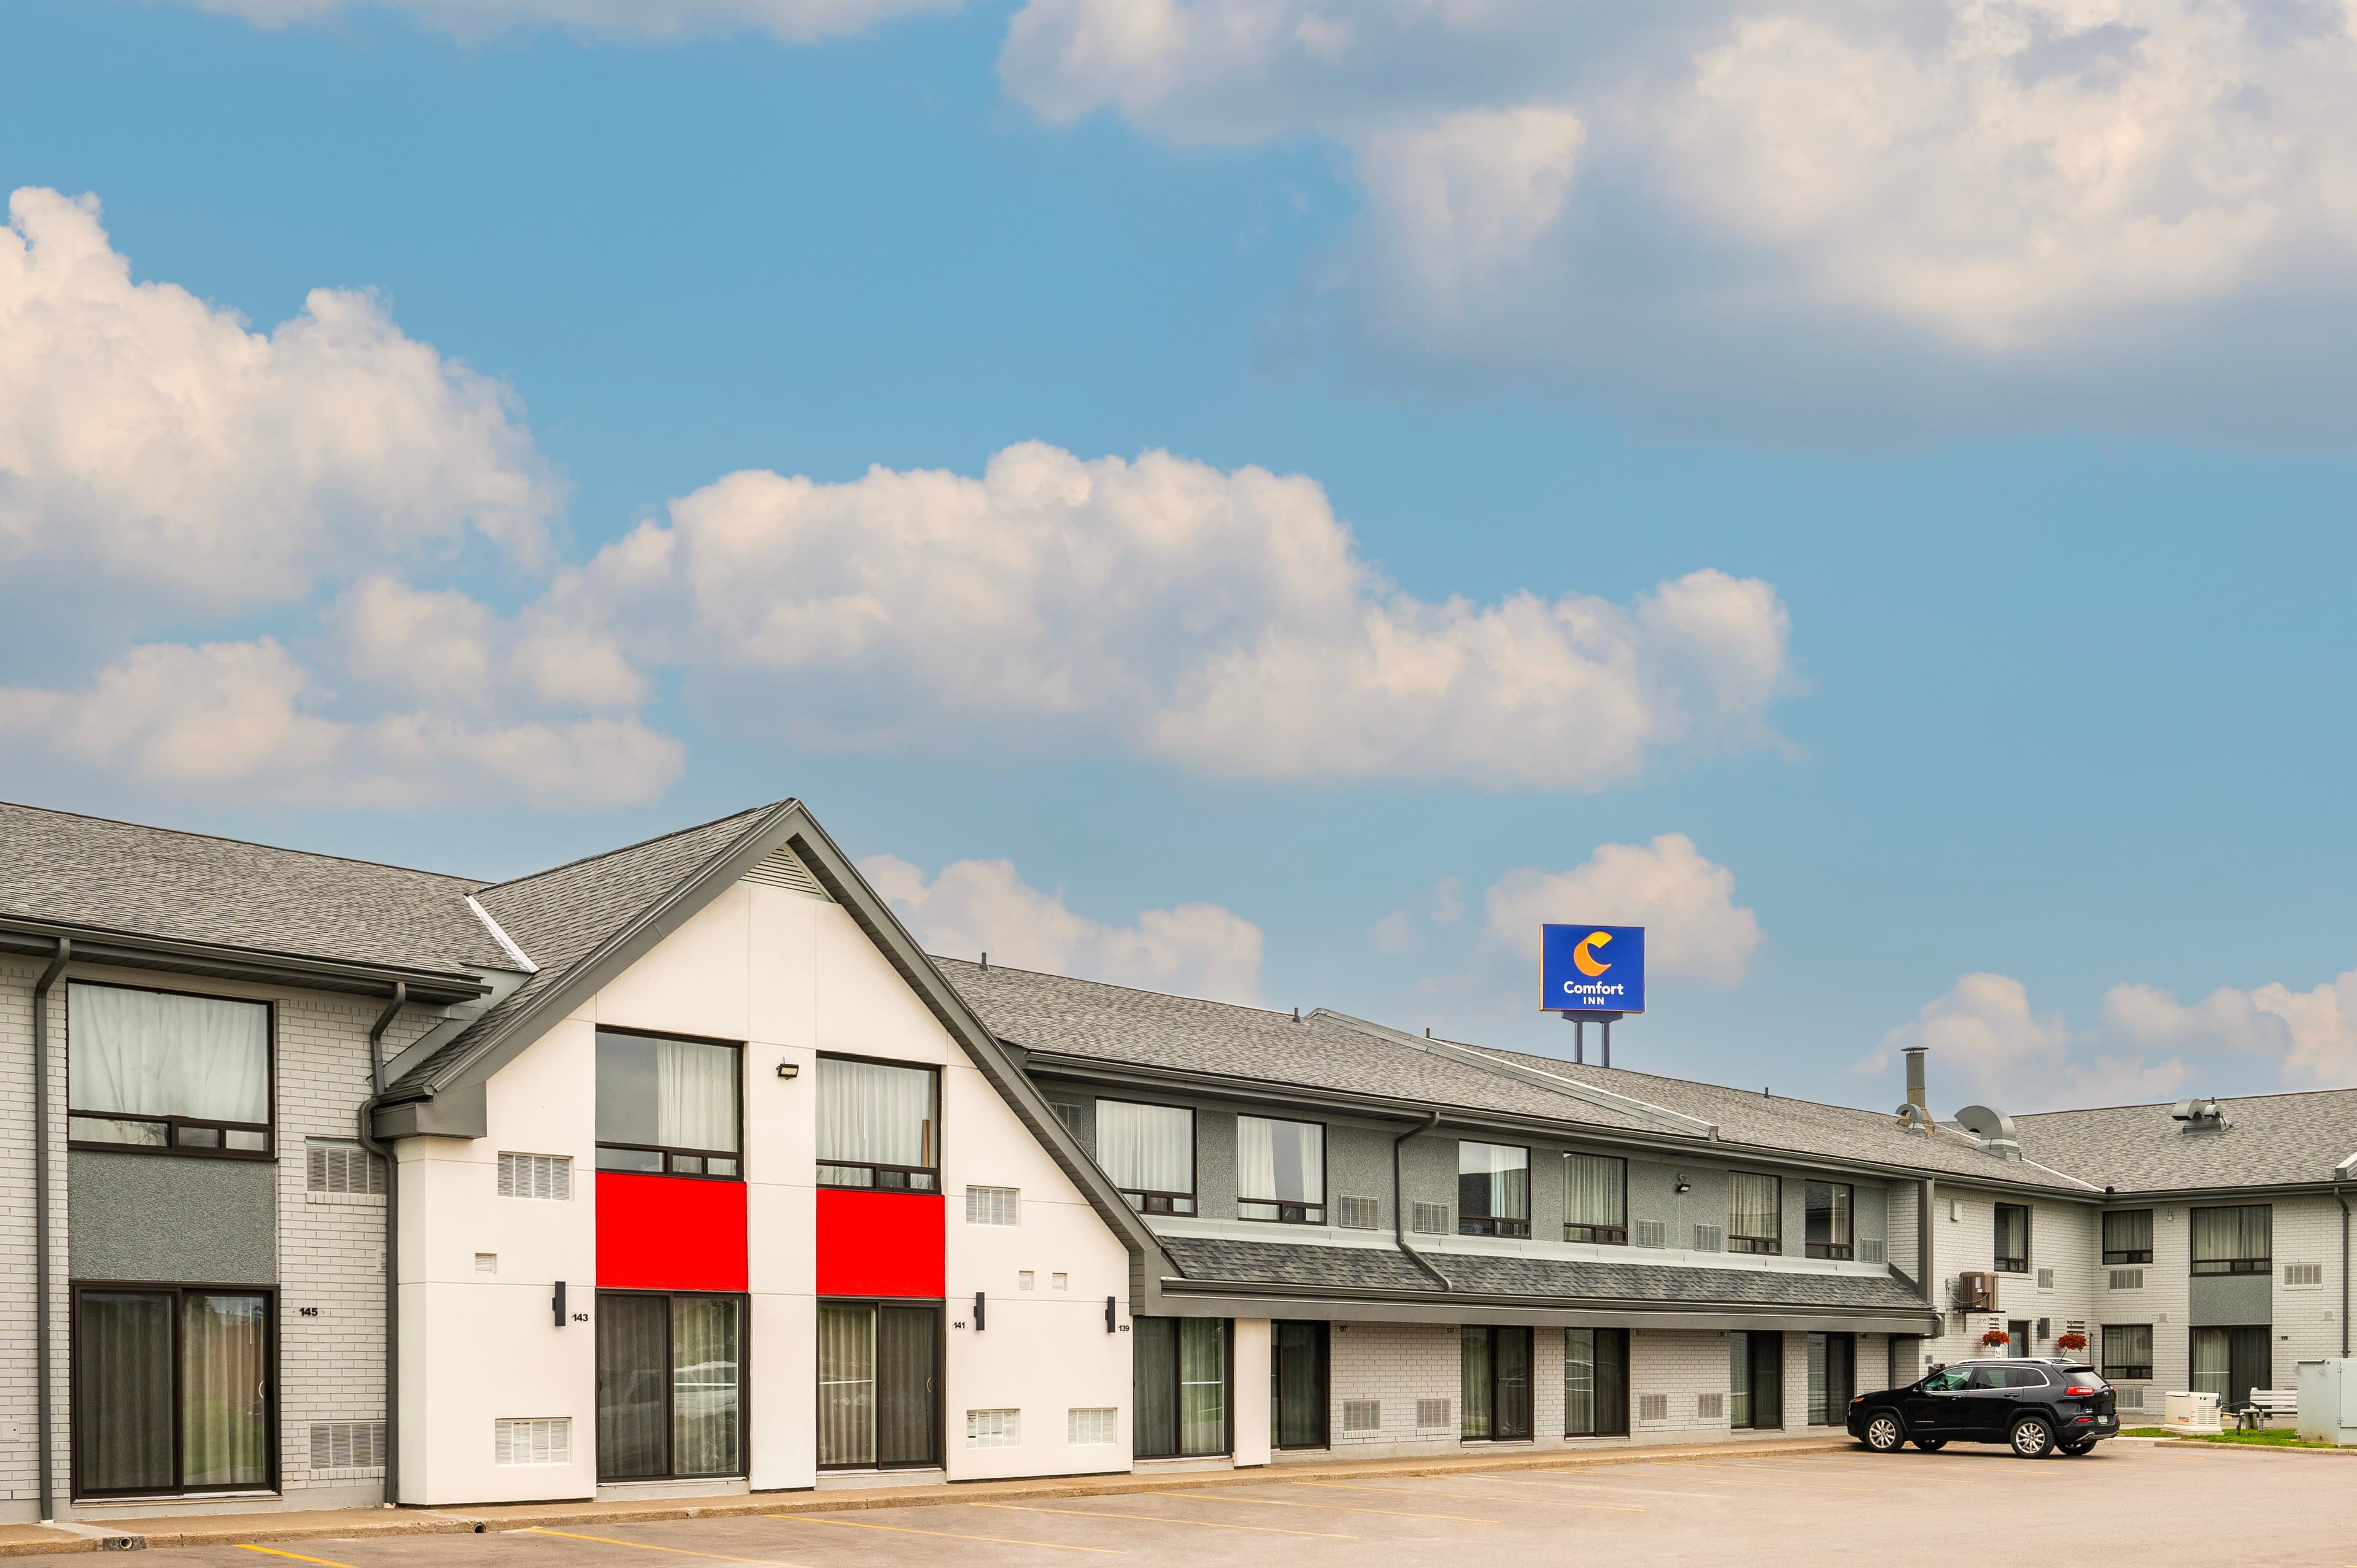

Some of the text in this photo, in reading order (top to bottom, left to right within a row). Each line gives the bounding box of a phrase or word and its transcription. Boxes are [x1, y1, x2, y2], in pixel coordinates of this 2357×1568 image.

[1563, 981, 1624, 995] Comfort
[1583, 996, 1604, 1005] INN
[299, 1307, 318, 1316] 145
[571, 1313, 589, 1322] 143
